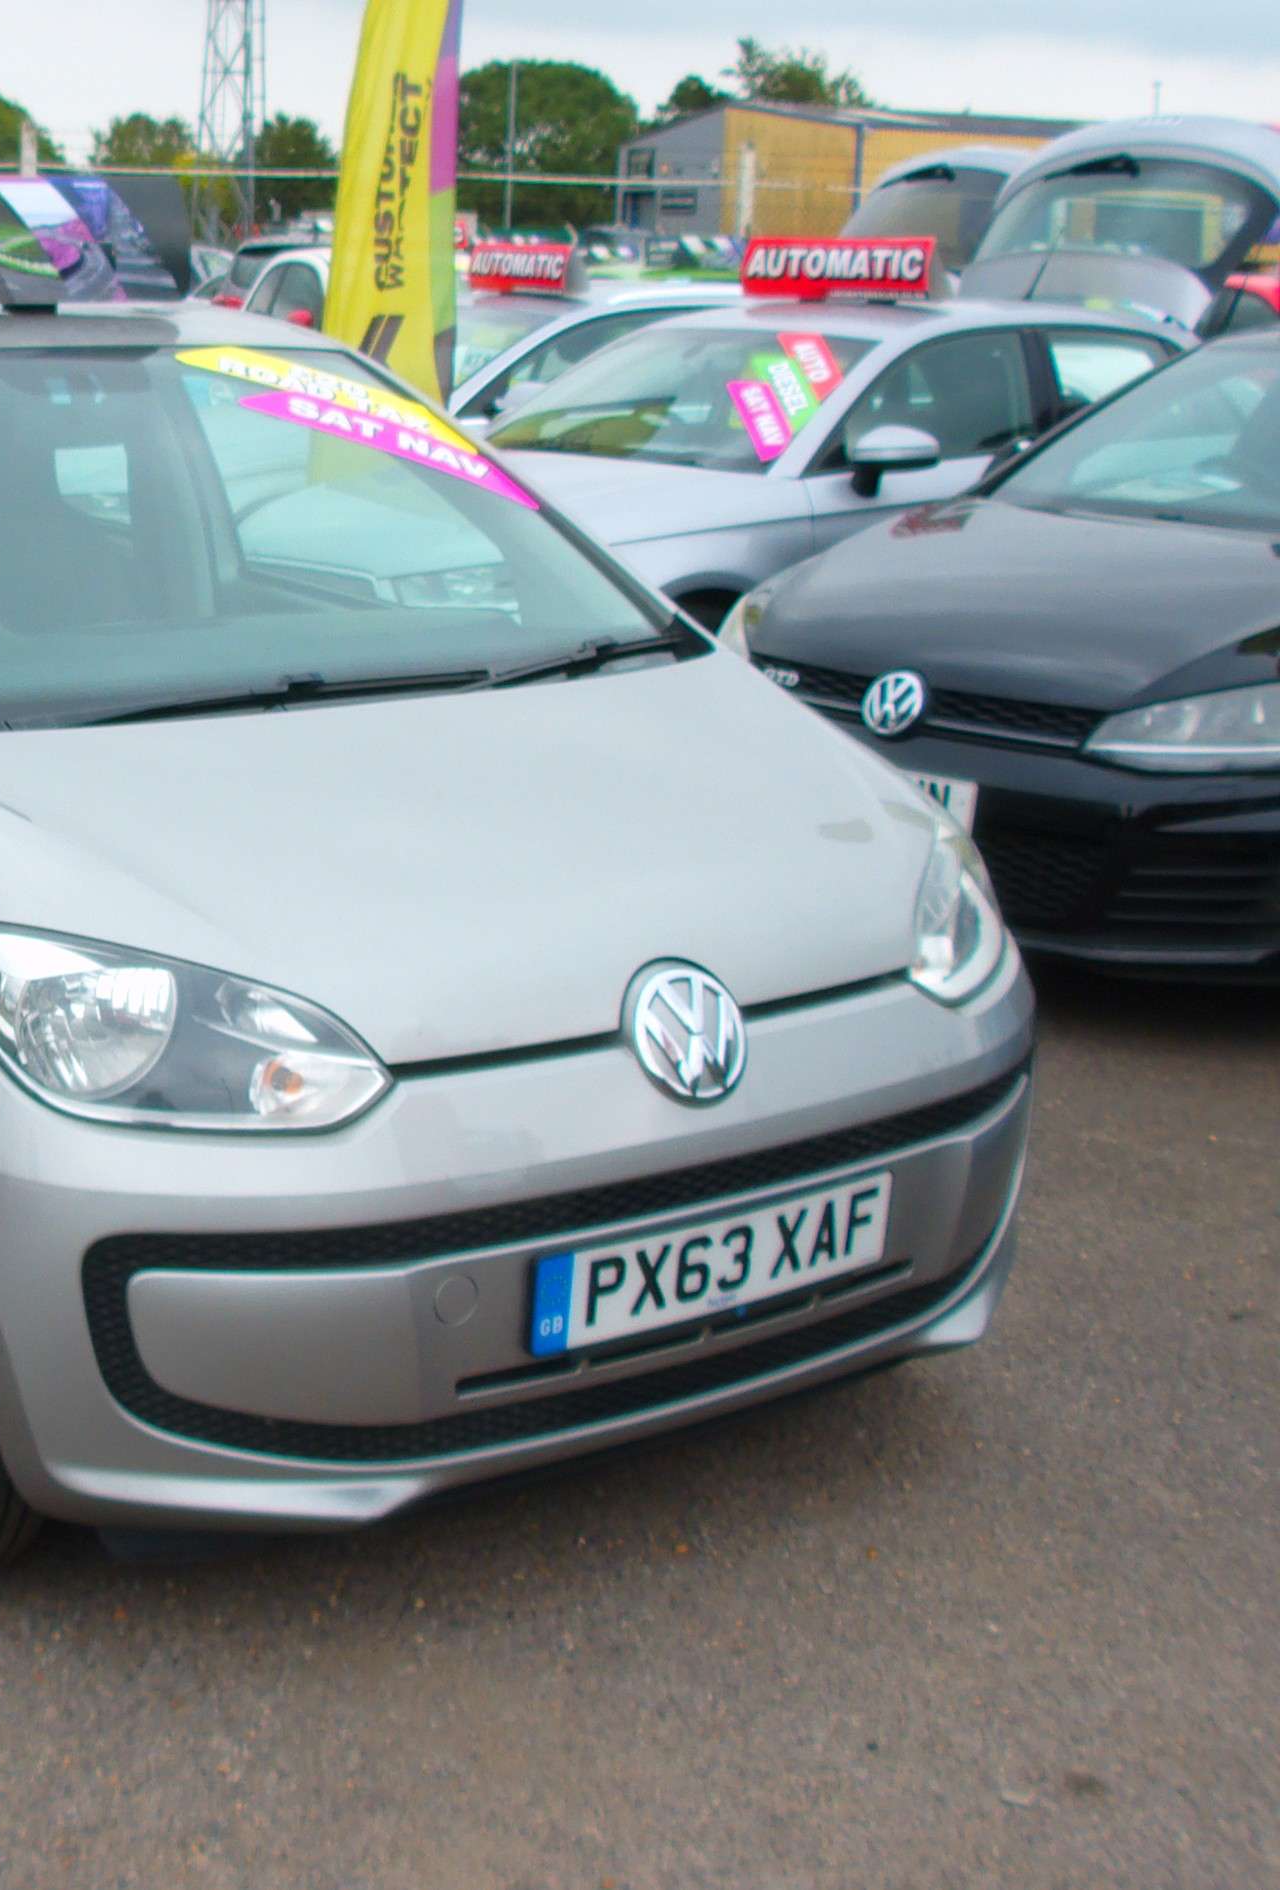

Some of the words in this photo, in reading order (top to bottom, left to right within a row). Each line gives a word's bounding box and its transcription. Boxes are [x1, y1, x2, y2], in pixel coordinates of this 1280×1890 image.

[472, 251, 566, 280] AUTOMATIC
[747, 246, 925, 281] AUTOMATIC
[219, 357, 335, 400] ROAD
[793, 341, 832, 383] AUTO
[740, 387, 772, 413] SAT
[767, 360, 809, 416] DIESEL
[287, 397, 384, 439] SAT
[397, 430, 489, 479] NAV
[755, 413, 785, 445] NAV
[585, 1224, 755, 1328] PX63
[770, 1187, 881, 1280] XAF
[539, 1315, 564, 1336] GB
